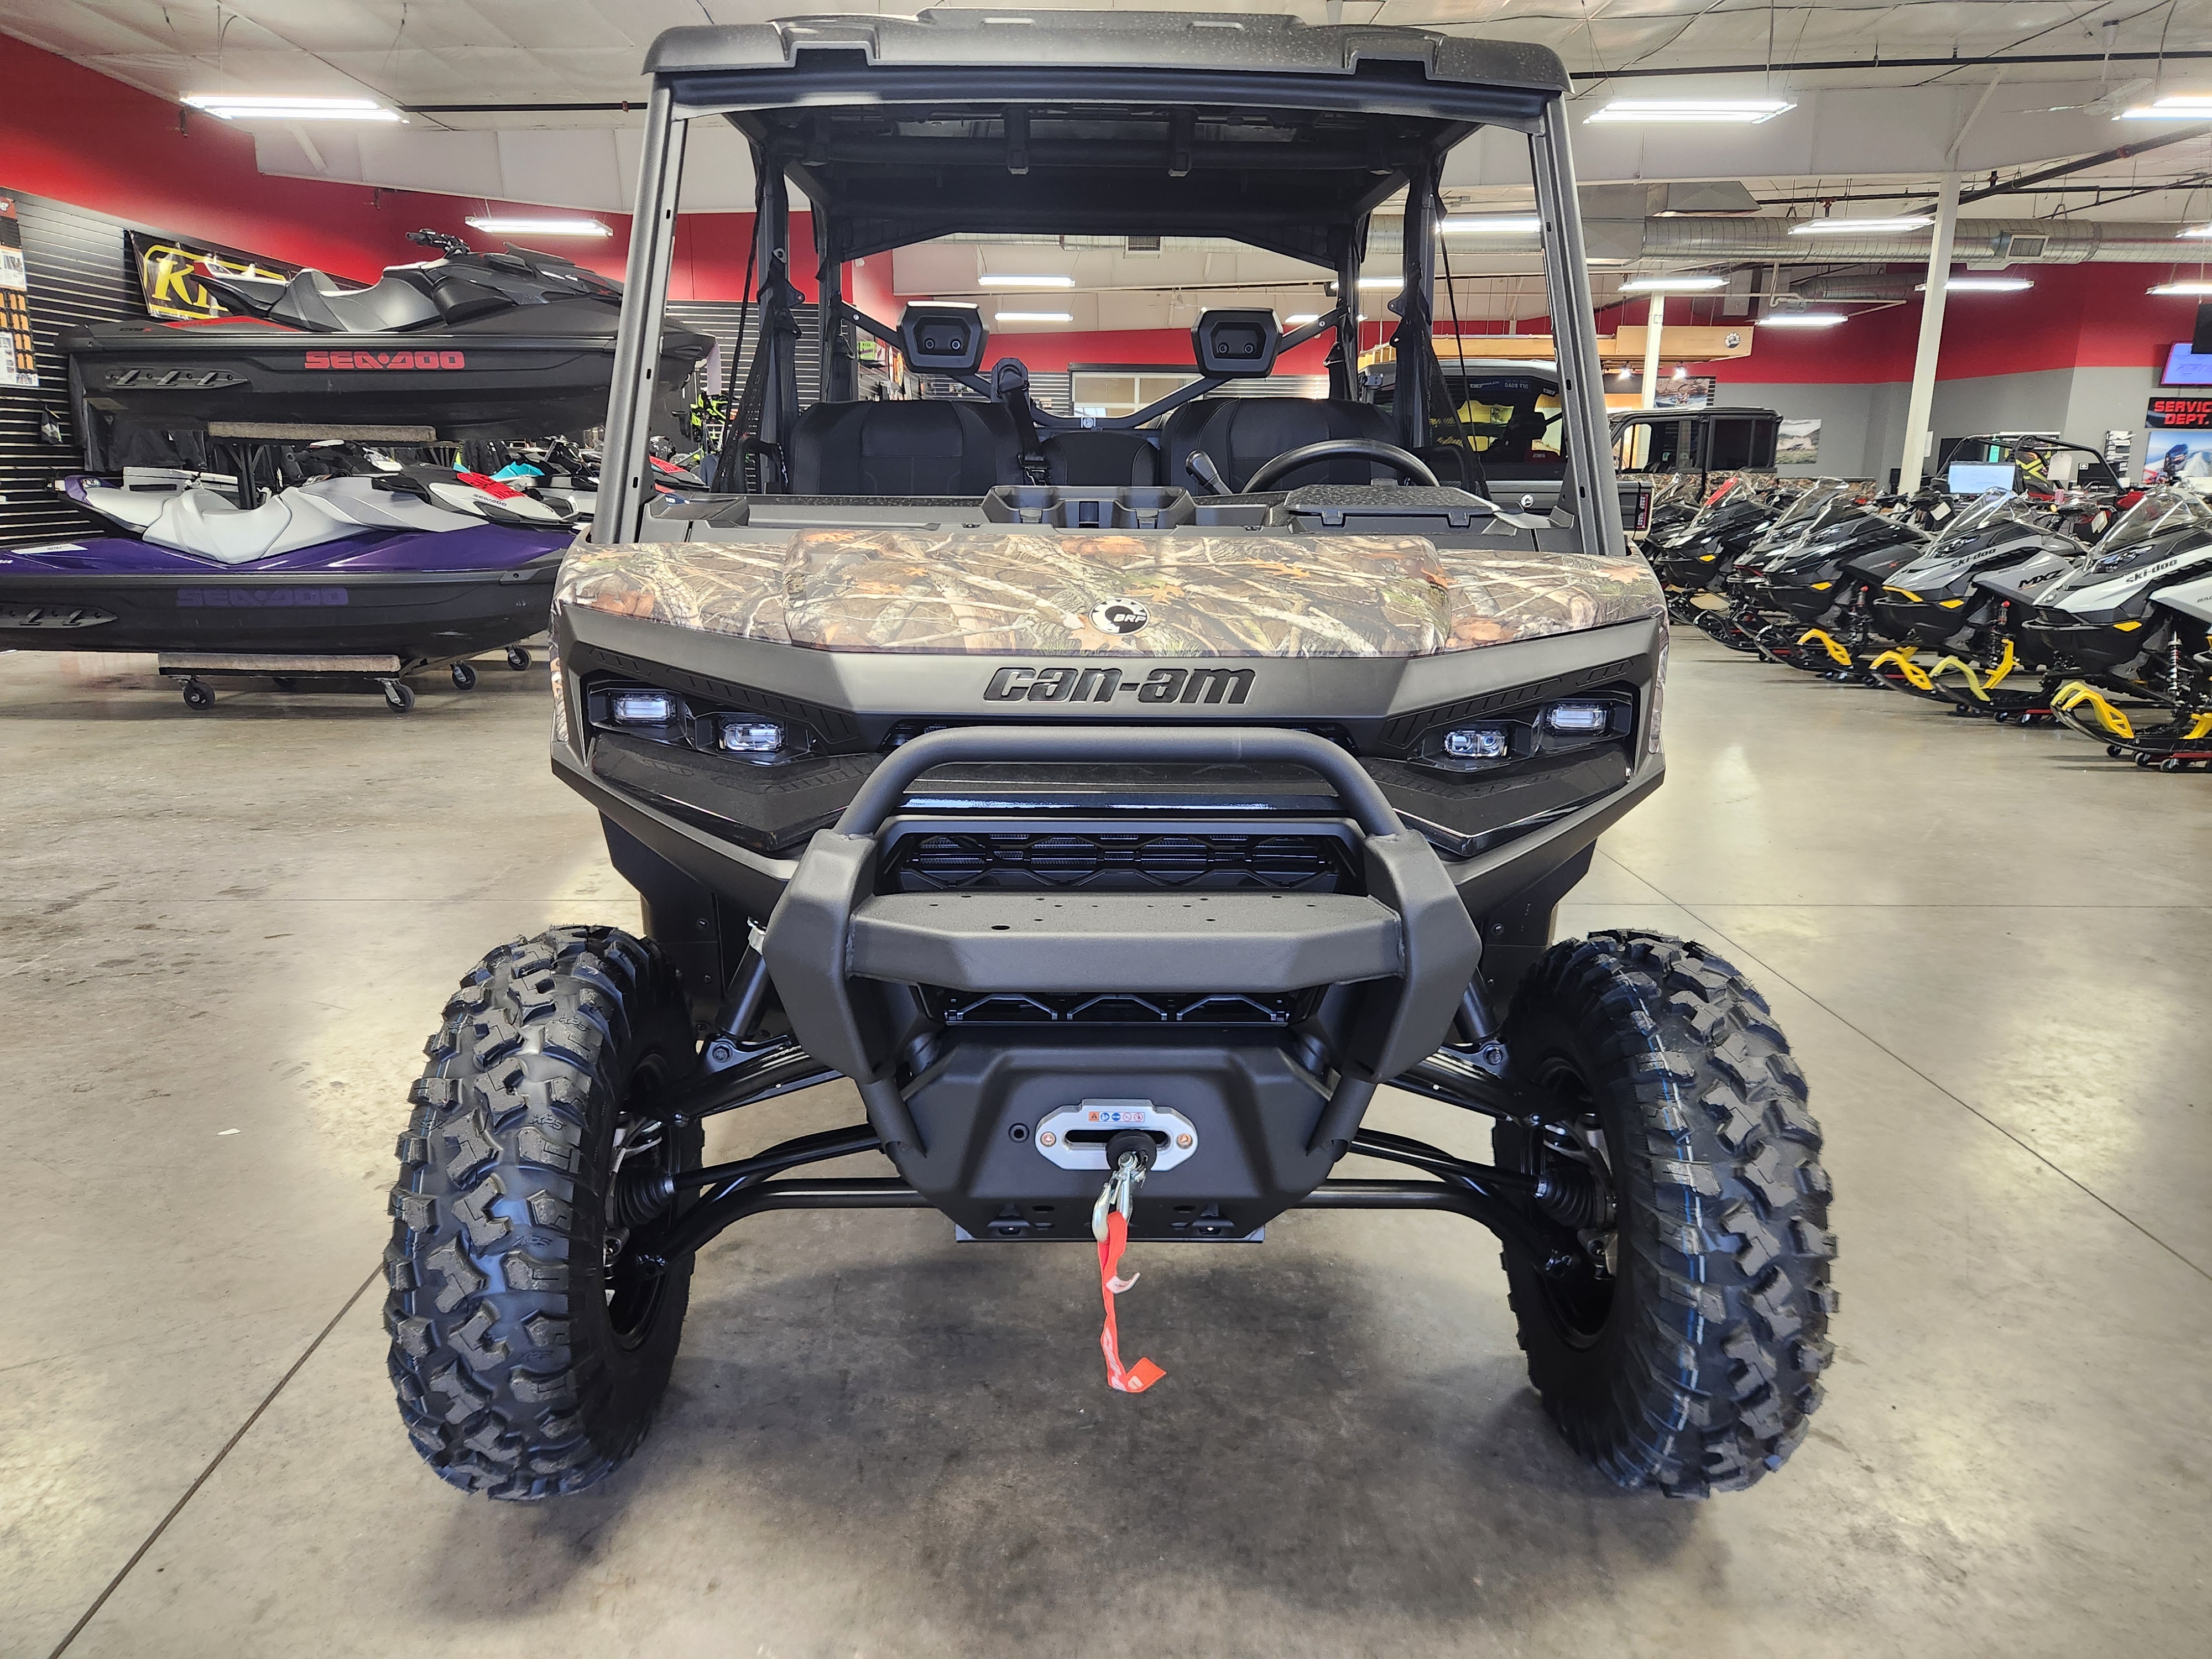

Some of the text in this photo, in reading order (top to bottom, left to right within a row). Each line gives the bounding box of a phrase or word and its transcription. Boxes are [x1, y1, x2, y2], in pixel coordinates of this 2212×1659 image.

[2164, 413, 2210, 425] DEPT.
[2018, 568, 2065, 588] MXZ
[1113, 613, 1147, 623] BRP
